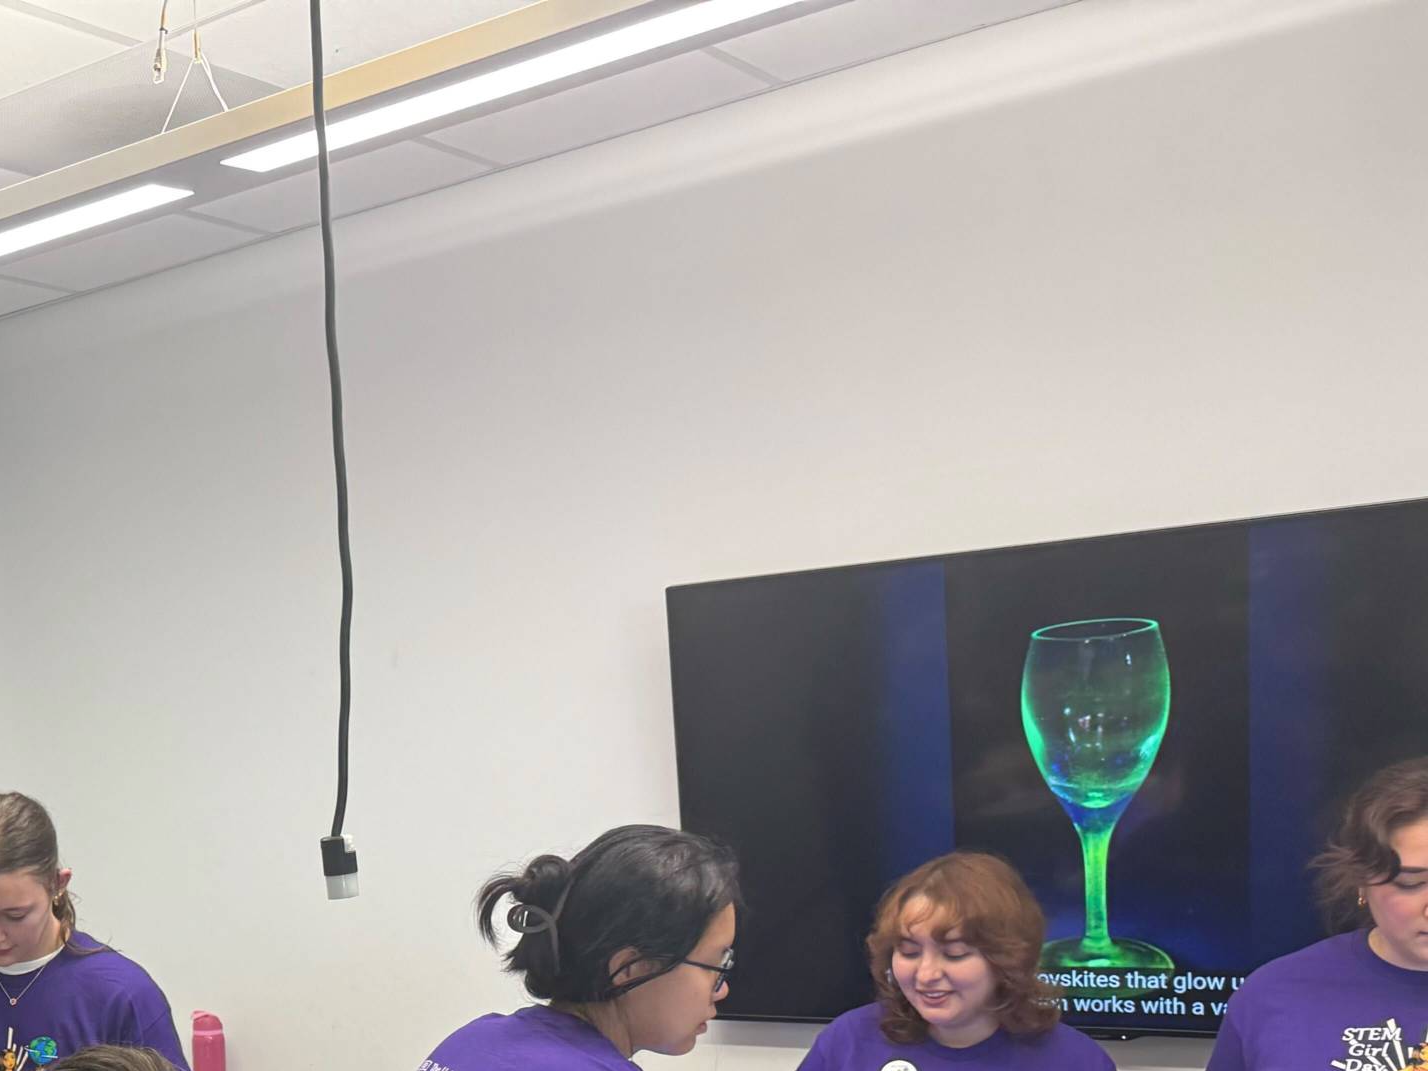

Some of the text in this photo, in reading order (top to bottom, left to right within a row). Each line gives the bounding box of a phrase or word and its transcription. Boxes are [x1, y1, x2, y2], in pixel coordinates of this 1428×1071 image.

[1036, 970, 1120, 988] ovskites
[1125, 972, 1168, 989] that
[1173, 972, 1225, 994] glow
[1073, 996, 1136, 1013] works
[1141, 997, 1186, 1015] with
[1191, 1001, 1205, 1015] a
[1342, 1027, 1402, 1041] STEM
[1348, 1042, 1390, 1057] Girl
